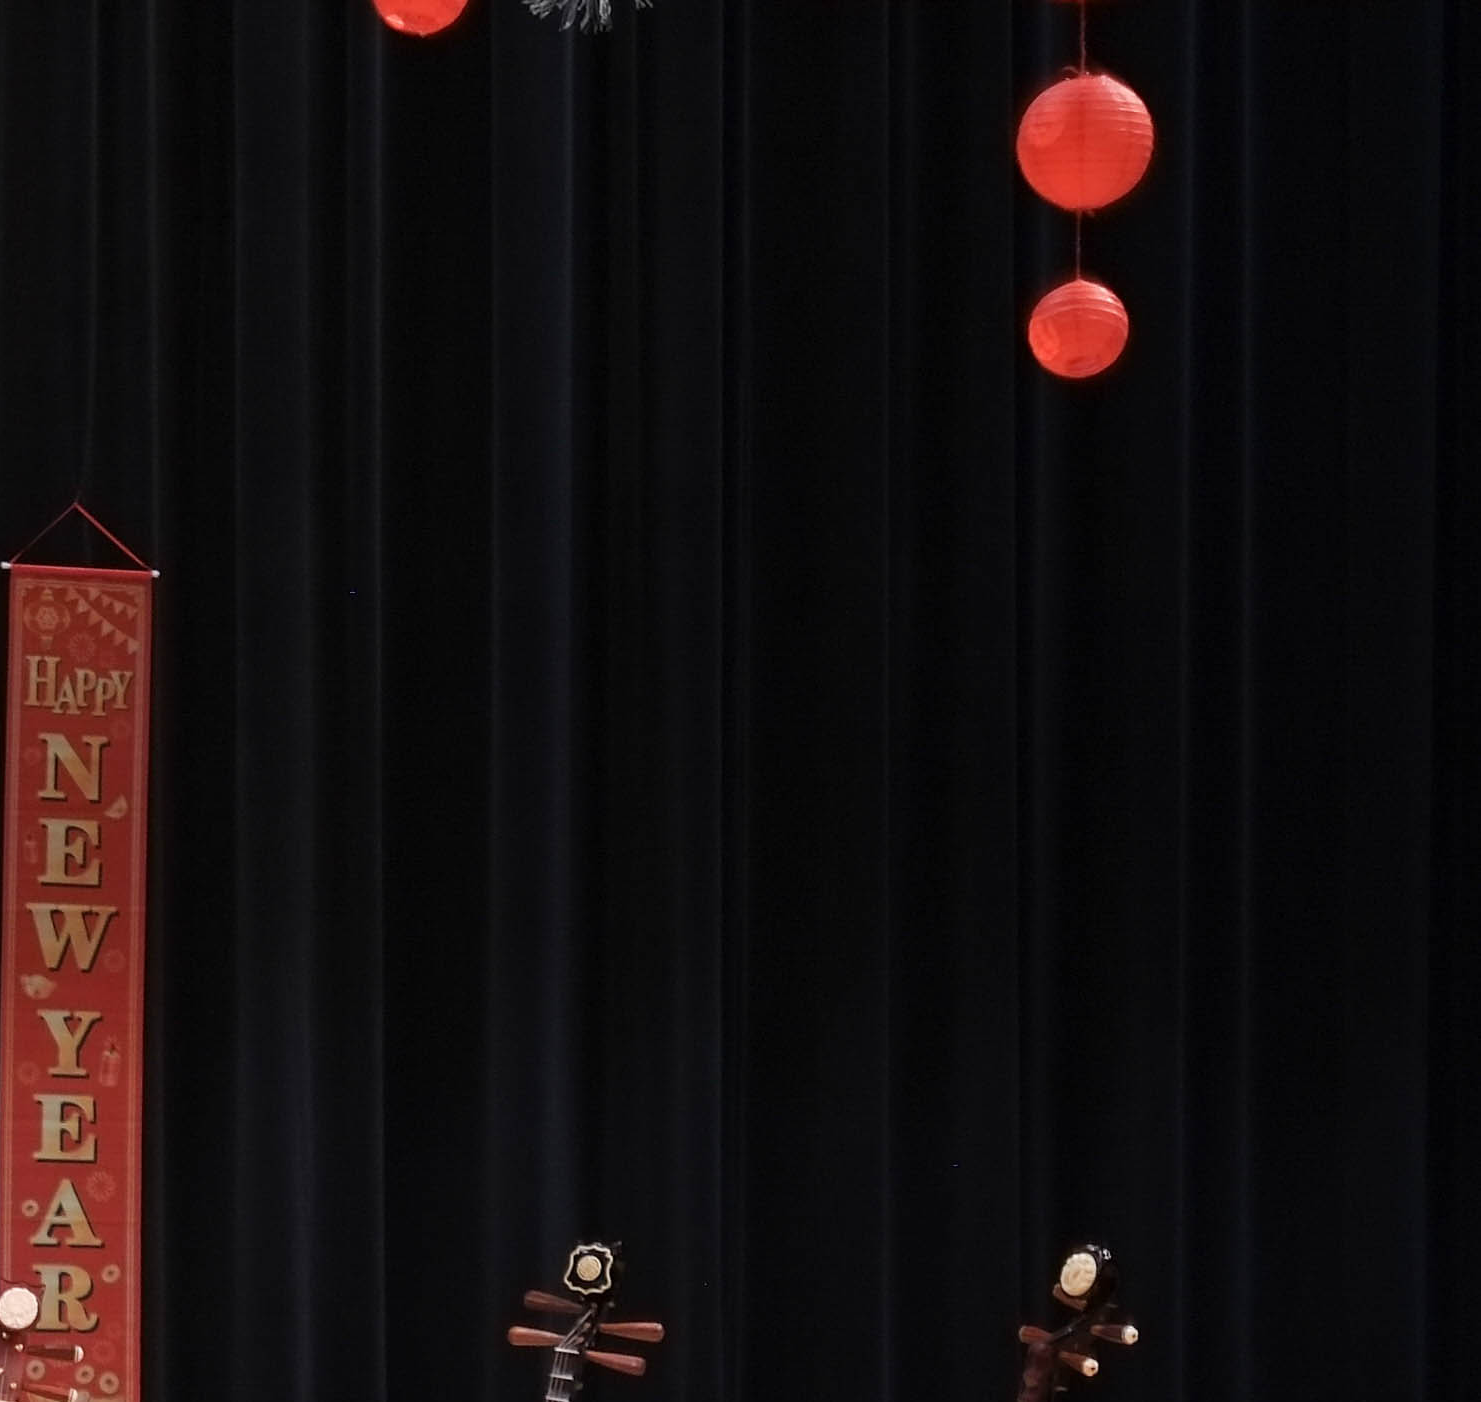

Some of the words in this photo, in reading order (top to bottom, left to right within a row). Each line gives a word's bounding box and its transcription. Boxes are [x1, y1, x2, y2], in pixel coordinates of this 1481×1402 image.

[24, 655, 134, 717] HAPPY
[25, 732, 118, 974] NEW
[29, 1008, 105, 1333] YEAR
